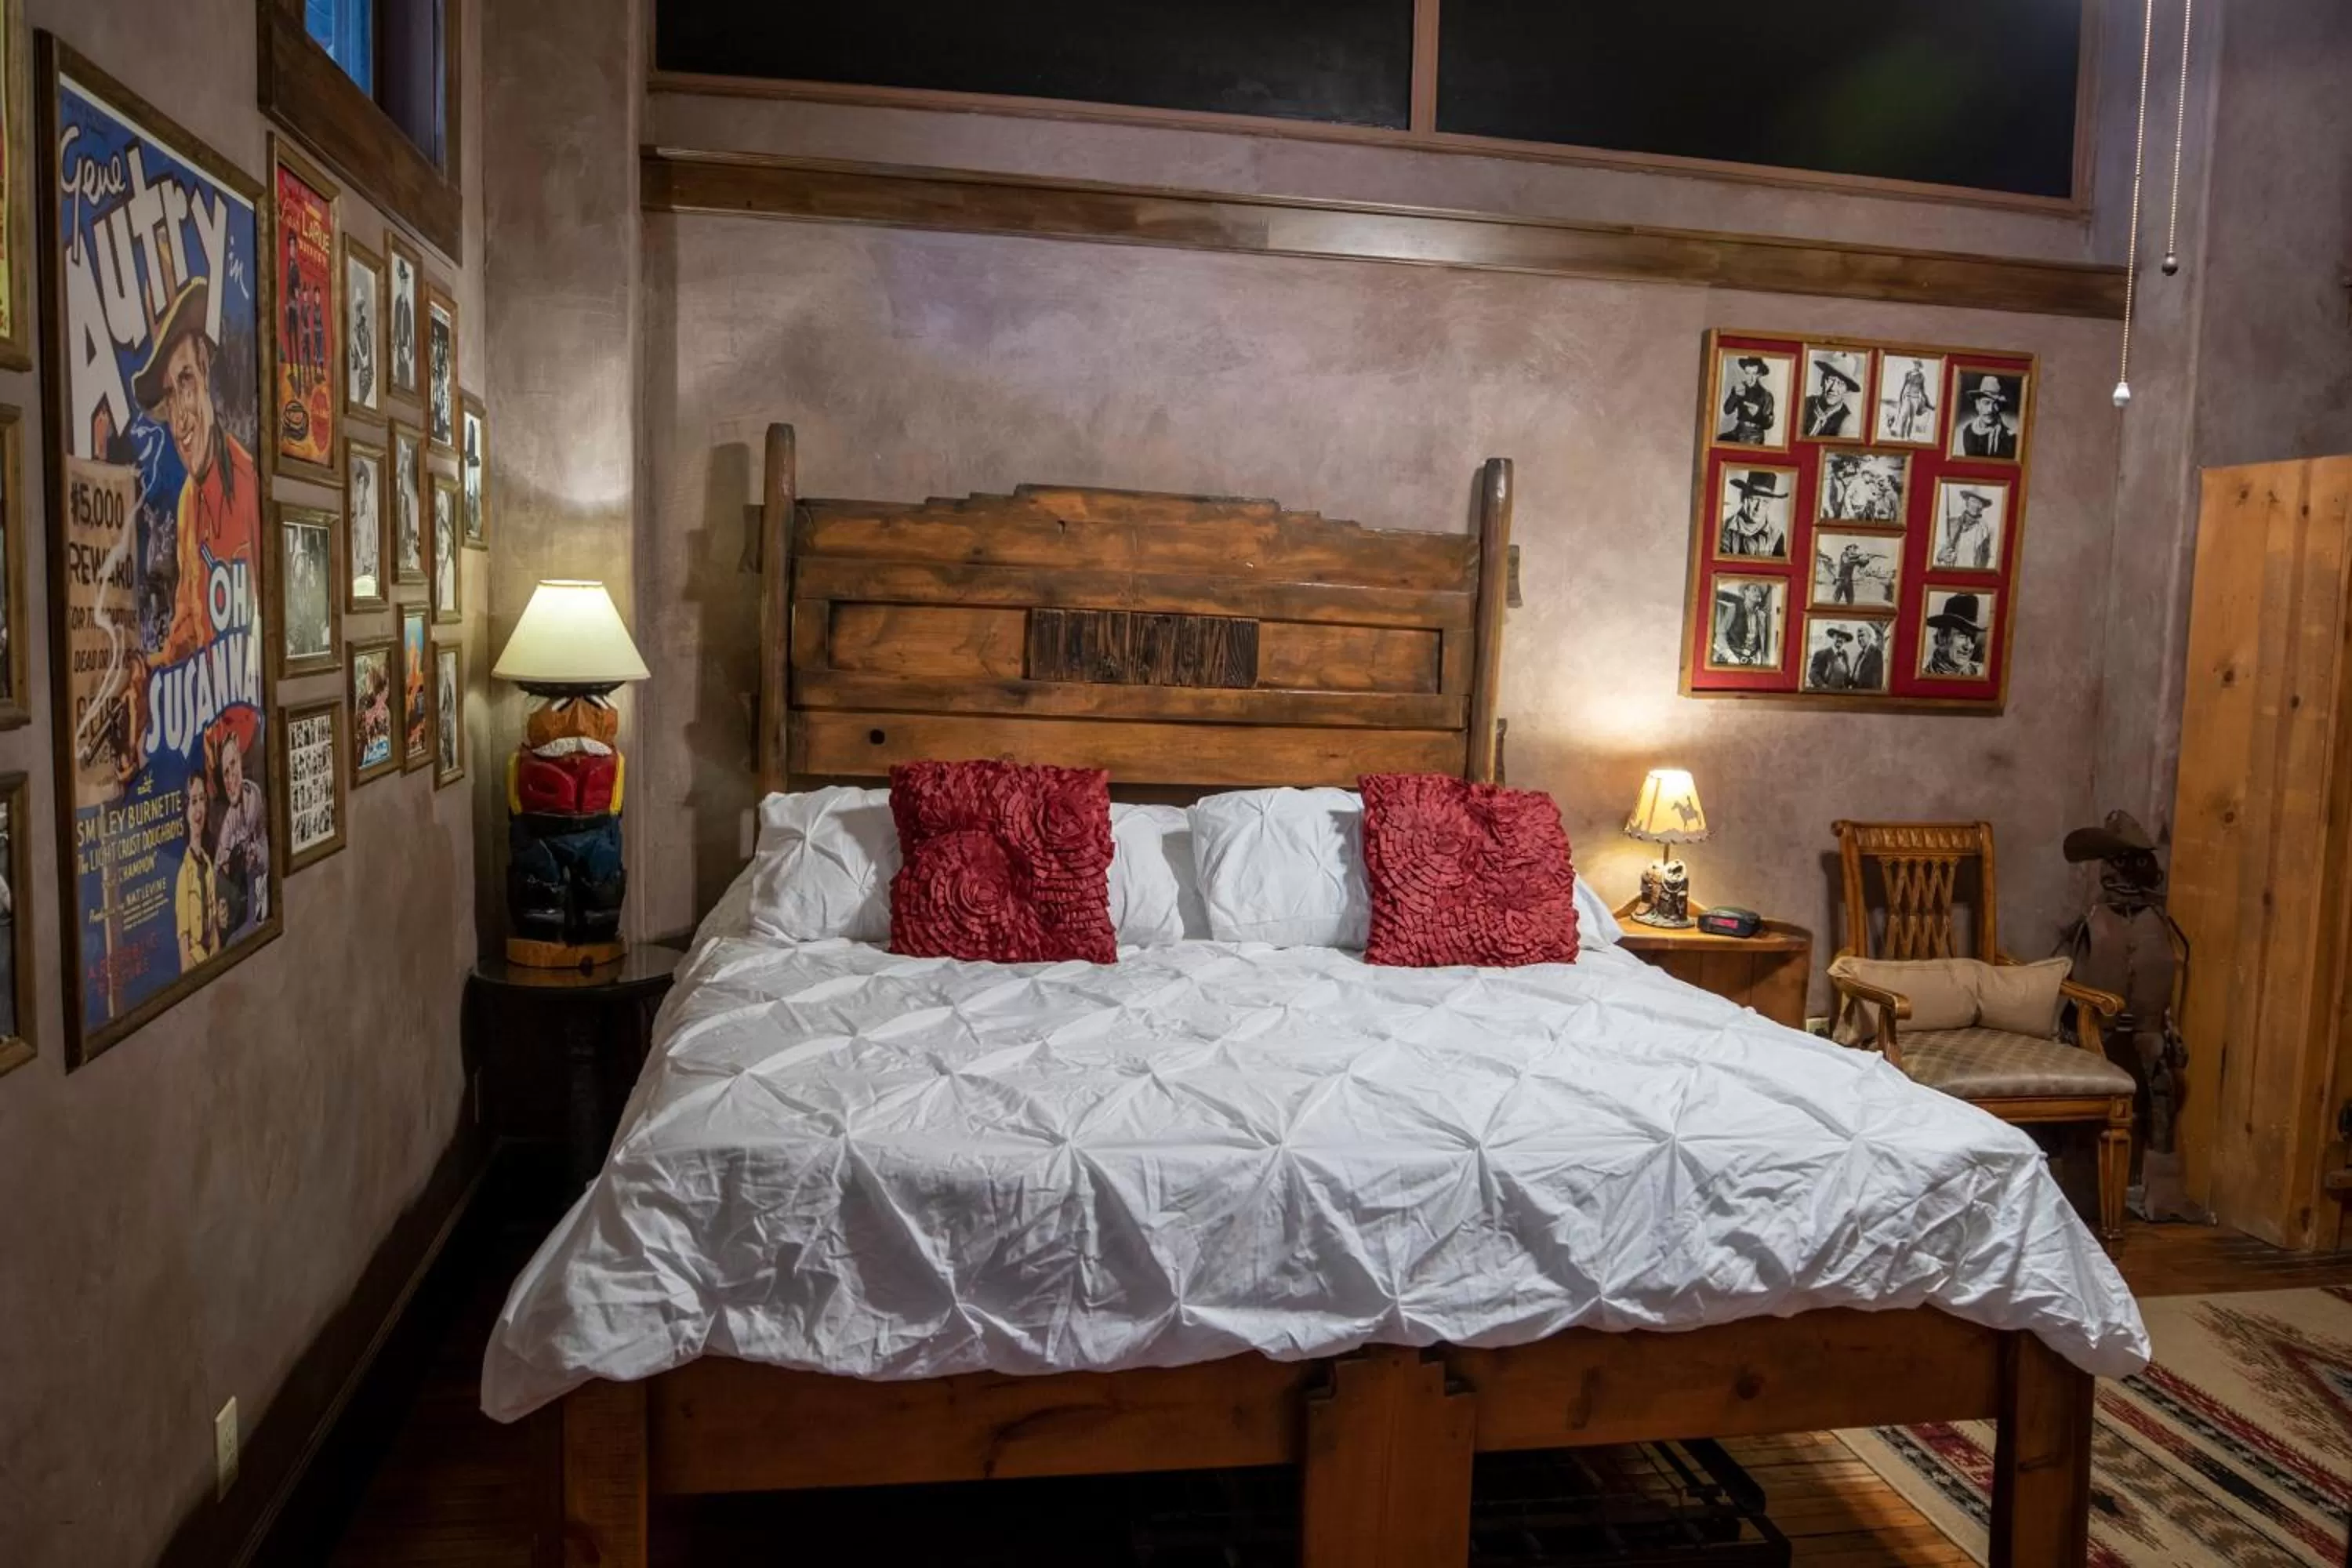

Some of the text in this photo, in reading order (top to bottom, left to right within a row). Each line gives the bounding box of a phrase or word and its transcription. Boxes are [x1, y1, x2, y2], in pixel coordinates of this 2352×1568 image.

[60, 125, 125, 261] Gene
[71, 481, 124, 531] $5,000
[128, 789, 181, 829] BURNETTE
